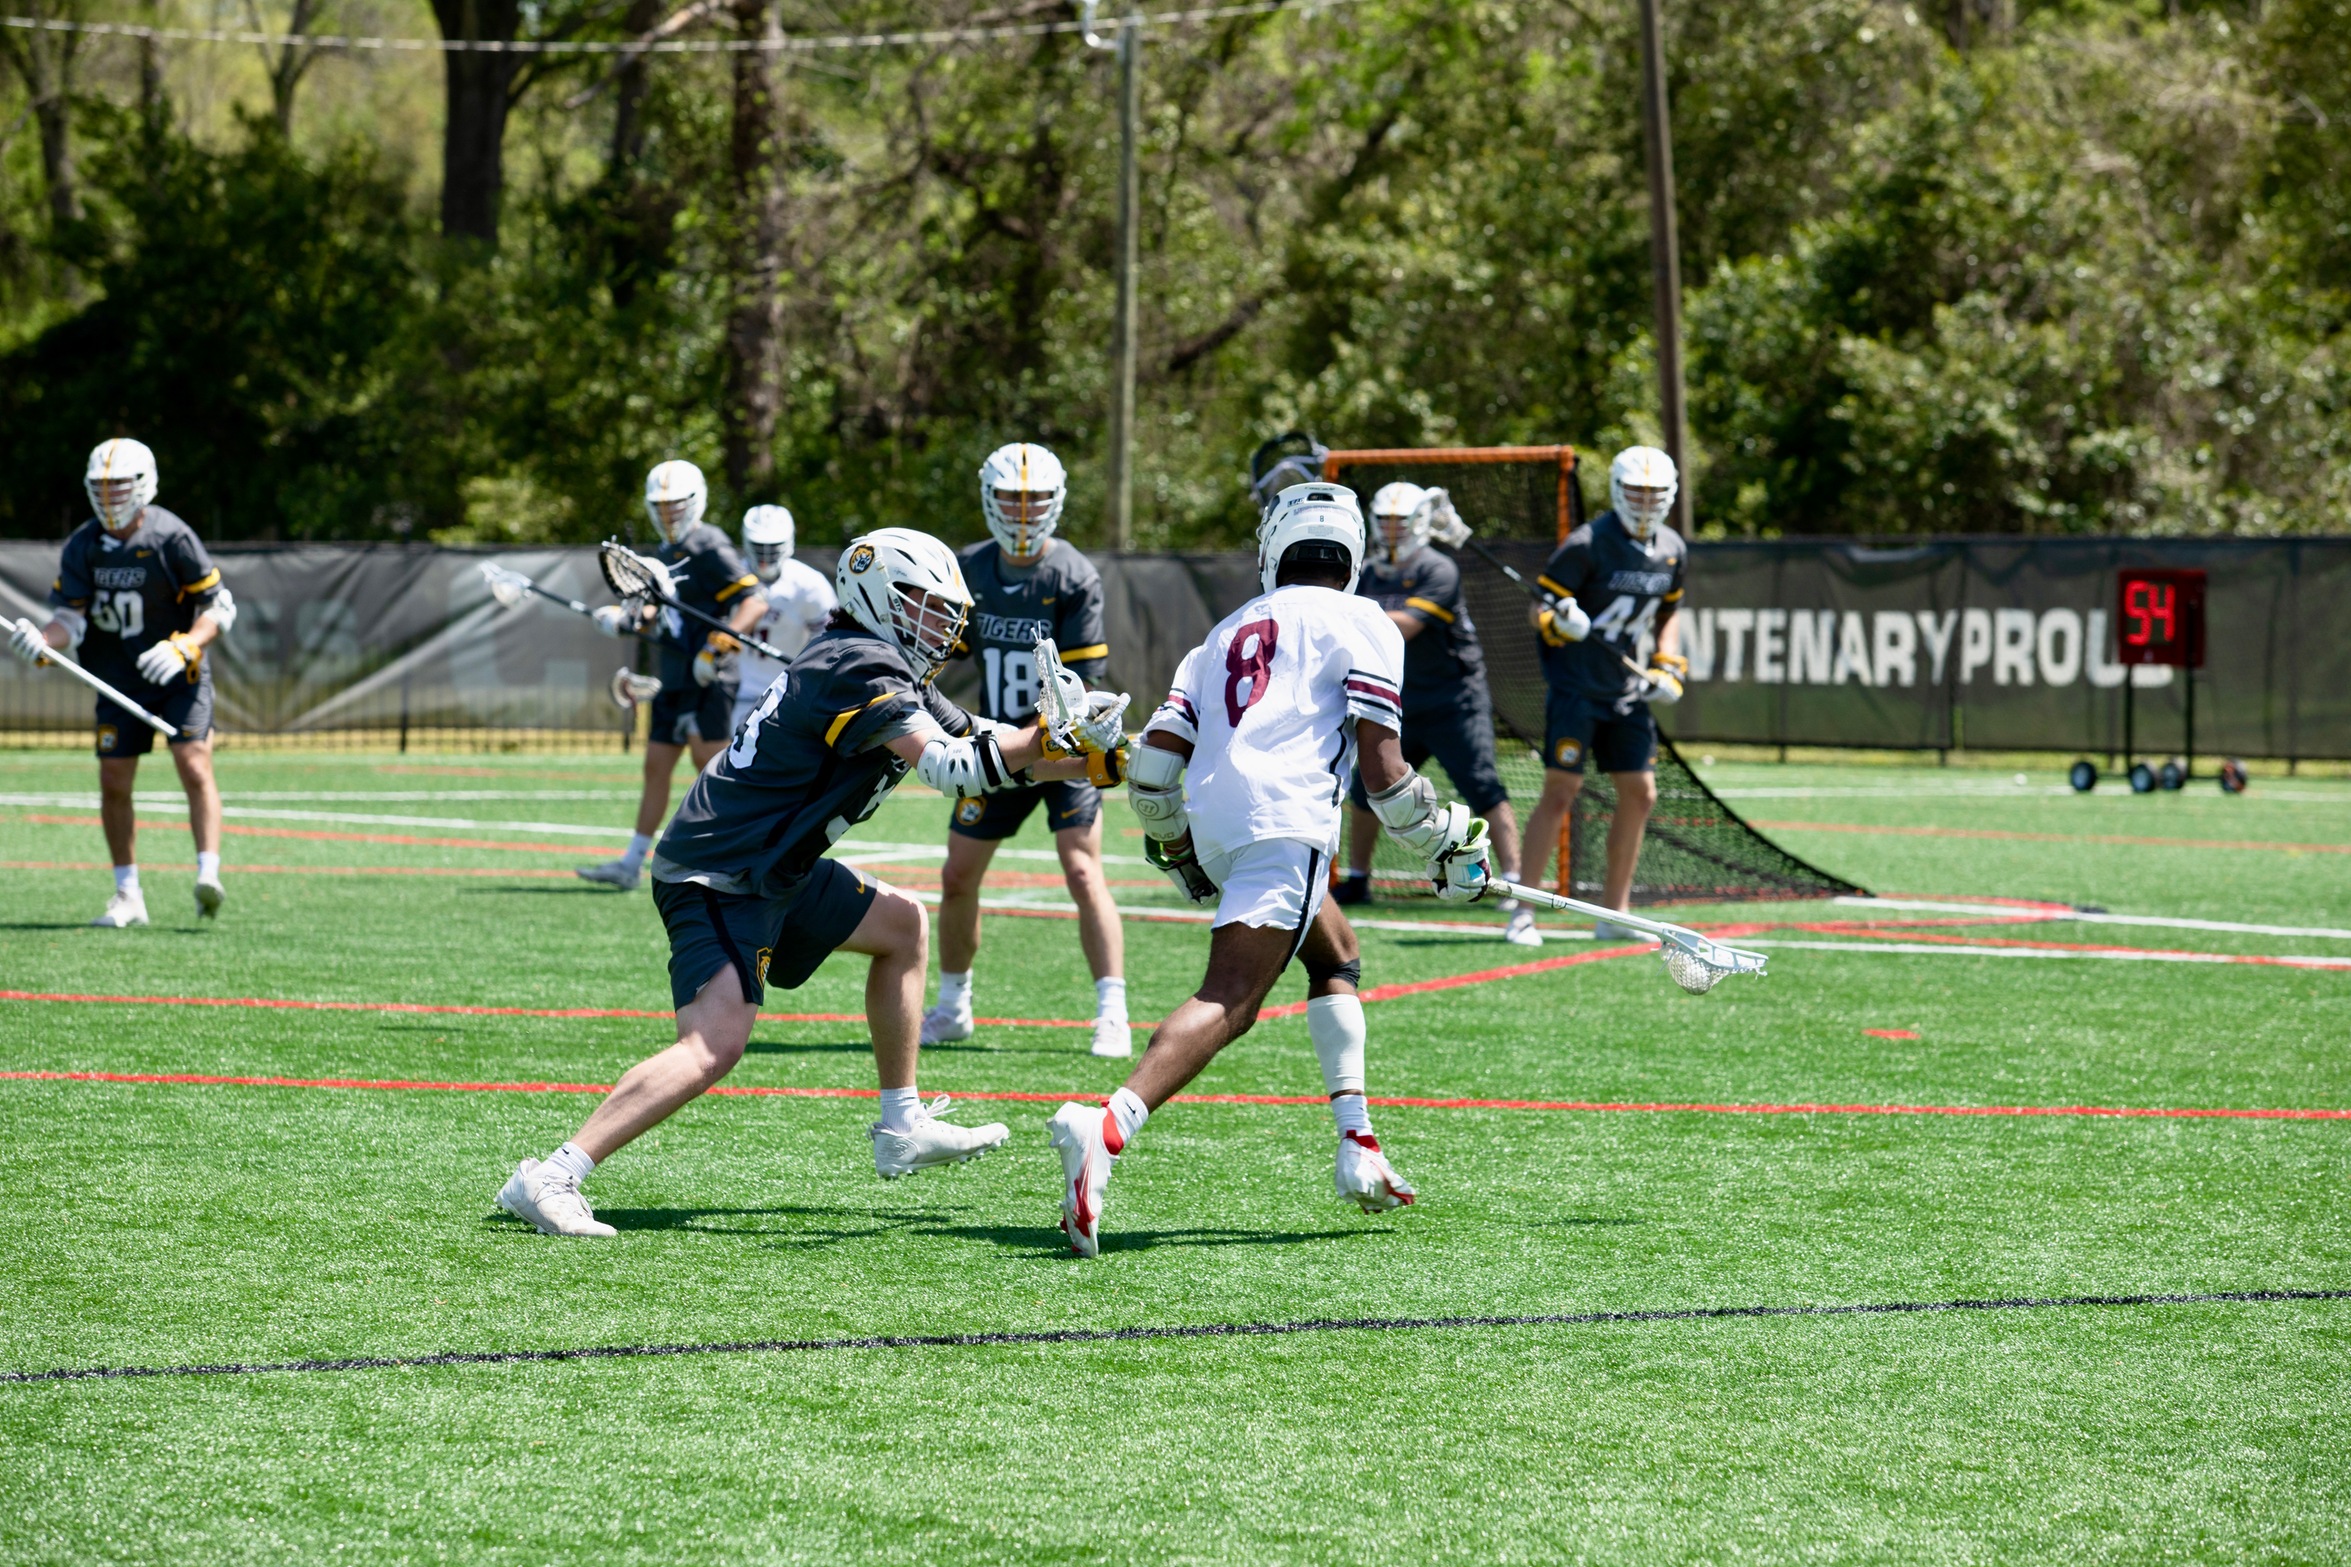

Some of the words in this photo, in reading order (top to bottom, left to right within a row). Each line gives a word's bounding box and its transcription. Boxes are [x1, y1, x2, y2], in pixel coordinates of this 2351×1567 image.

[976, 612, 1053, 643] TIGERS
[2125, 580, 2176, 646] 54
[983, 647, 1043, 719] 18
[1225, 619, 1279, 728] 8
